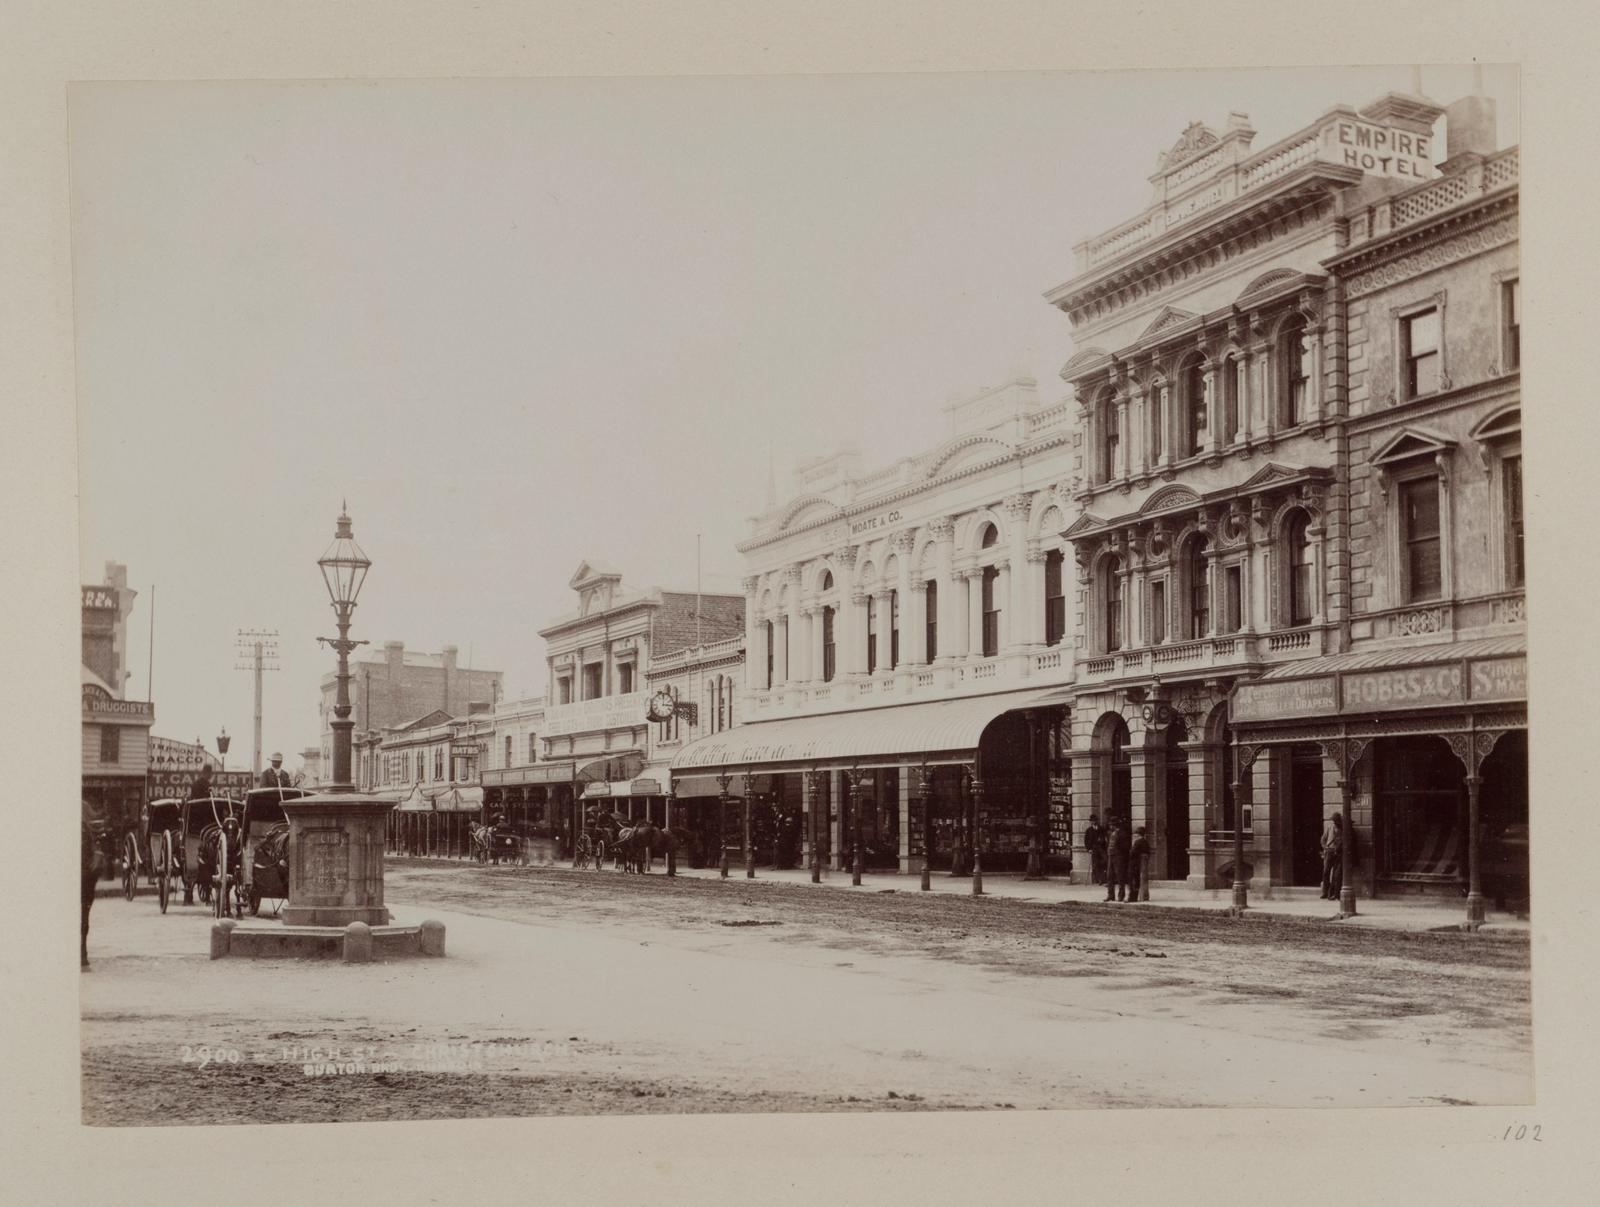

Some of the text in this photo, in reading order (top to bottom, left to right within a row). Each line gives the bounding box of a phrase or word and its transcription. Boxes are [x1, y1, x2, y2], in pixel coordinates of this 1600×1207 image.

[1339, 123, 1429, 160] EMPIRE
[852, 517, 878, 535] MOATE
[1345, 673, 1422, 704] HOBBS
[92, 701, 149, 714] DRUGGISTS
[1296, 696, 1335, 710] DRAPERS
[150, 756, 203, 764] OBACCO
[1503, 1124, 1543, 1142] 102
